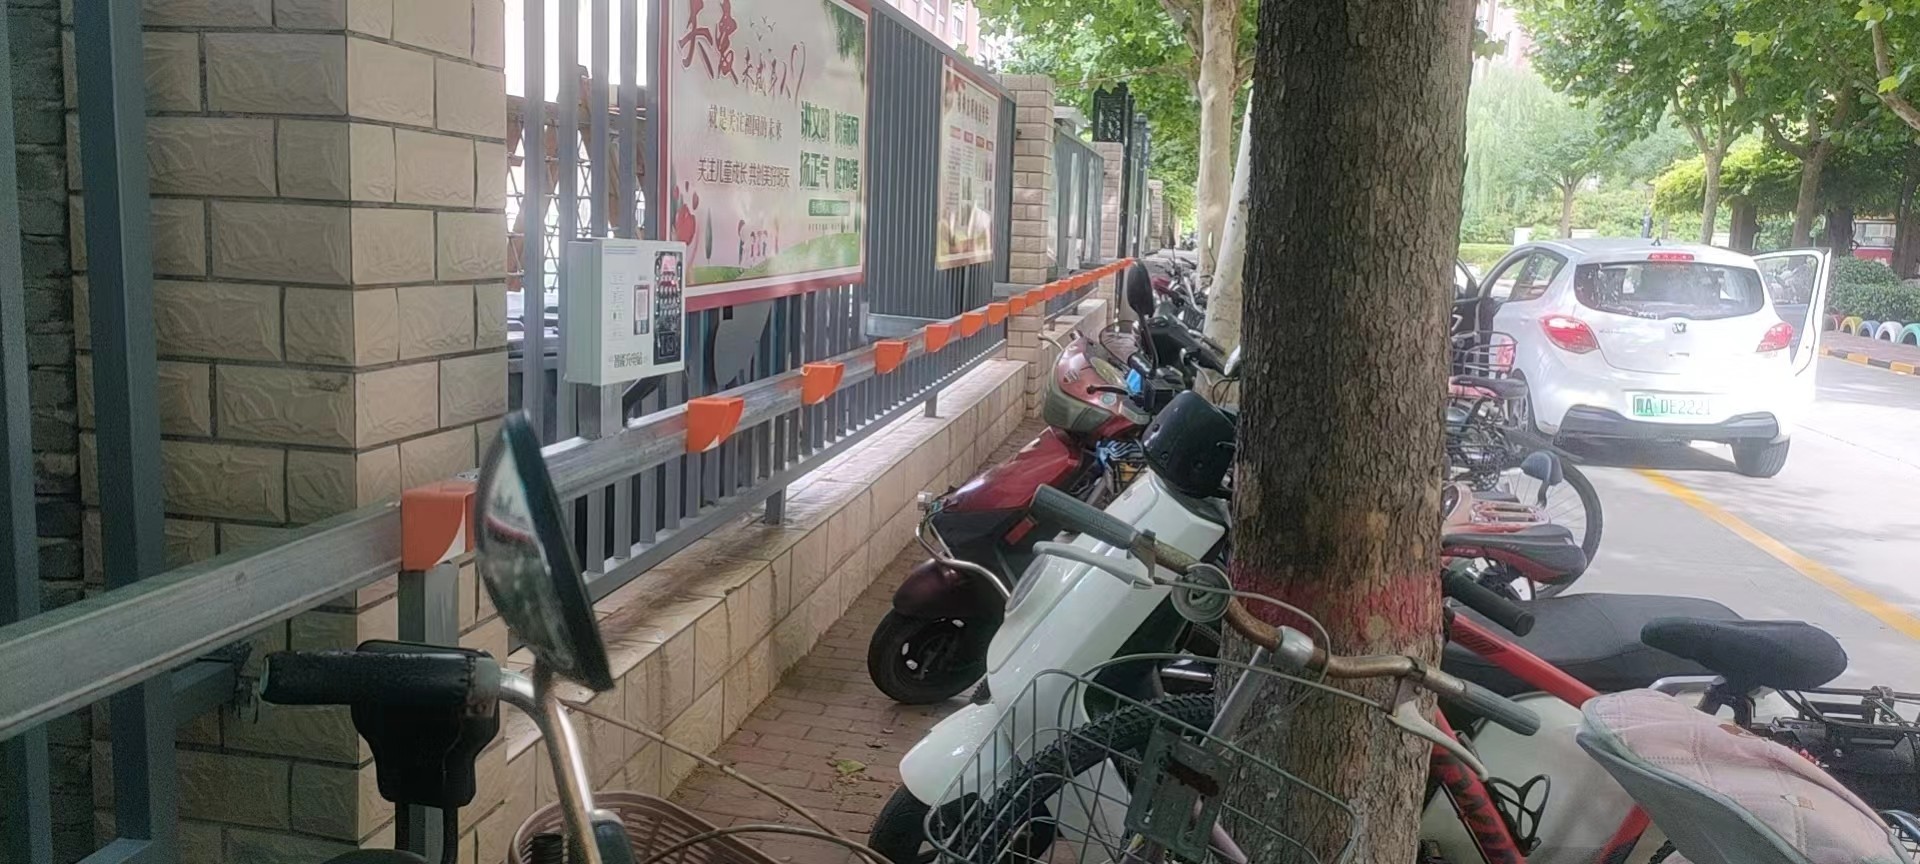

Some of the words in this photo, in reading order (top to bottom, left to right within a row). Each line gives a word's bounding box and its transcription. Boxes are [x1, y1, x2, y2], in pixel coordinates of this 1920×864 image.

[708, 104, 783, 141] 就是关注祖国的未来
[800, 101, 830, 141] 讲文明
[835, 110, 859, 146] 树新风
[697, 157, 747, 185] 关注儿童成长
[748, 161, 791, 188] 共创美好明天
[799, 150, 829, 189] 扬正气
[834, 156, 859, 190] 促和谐
